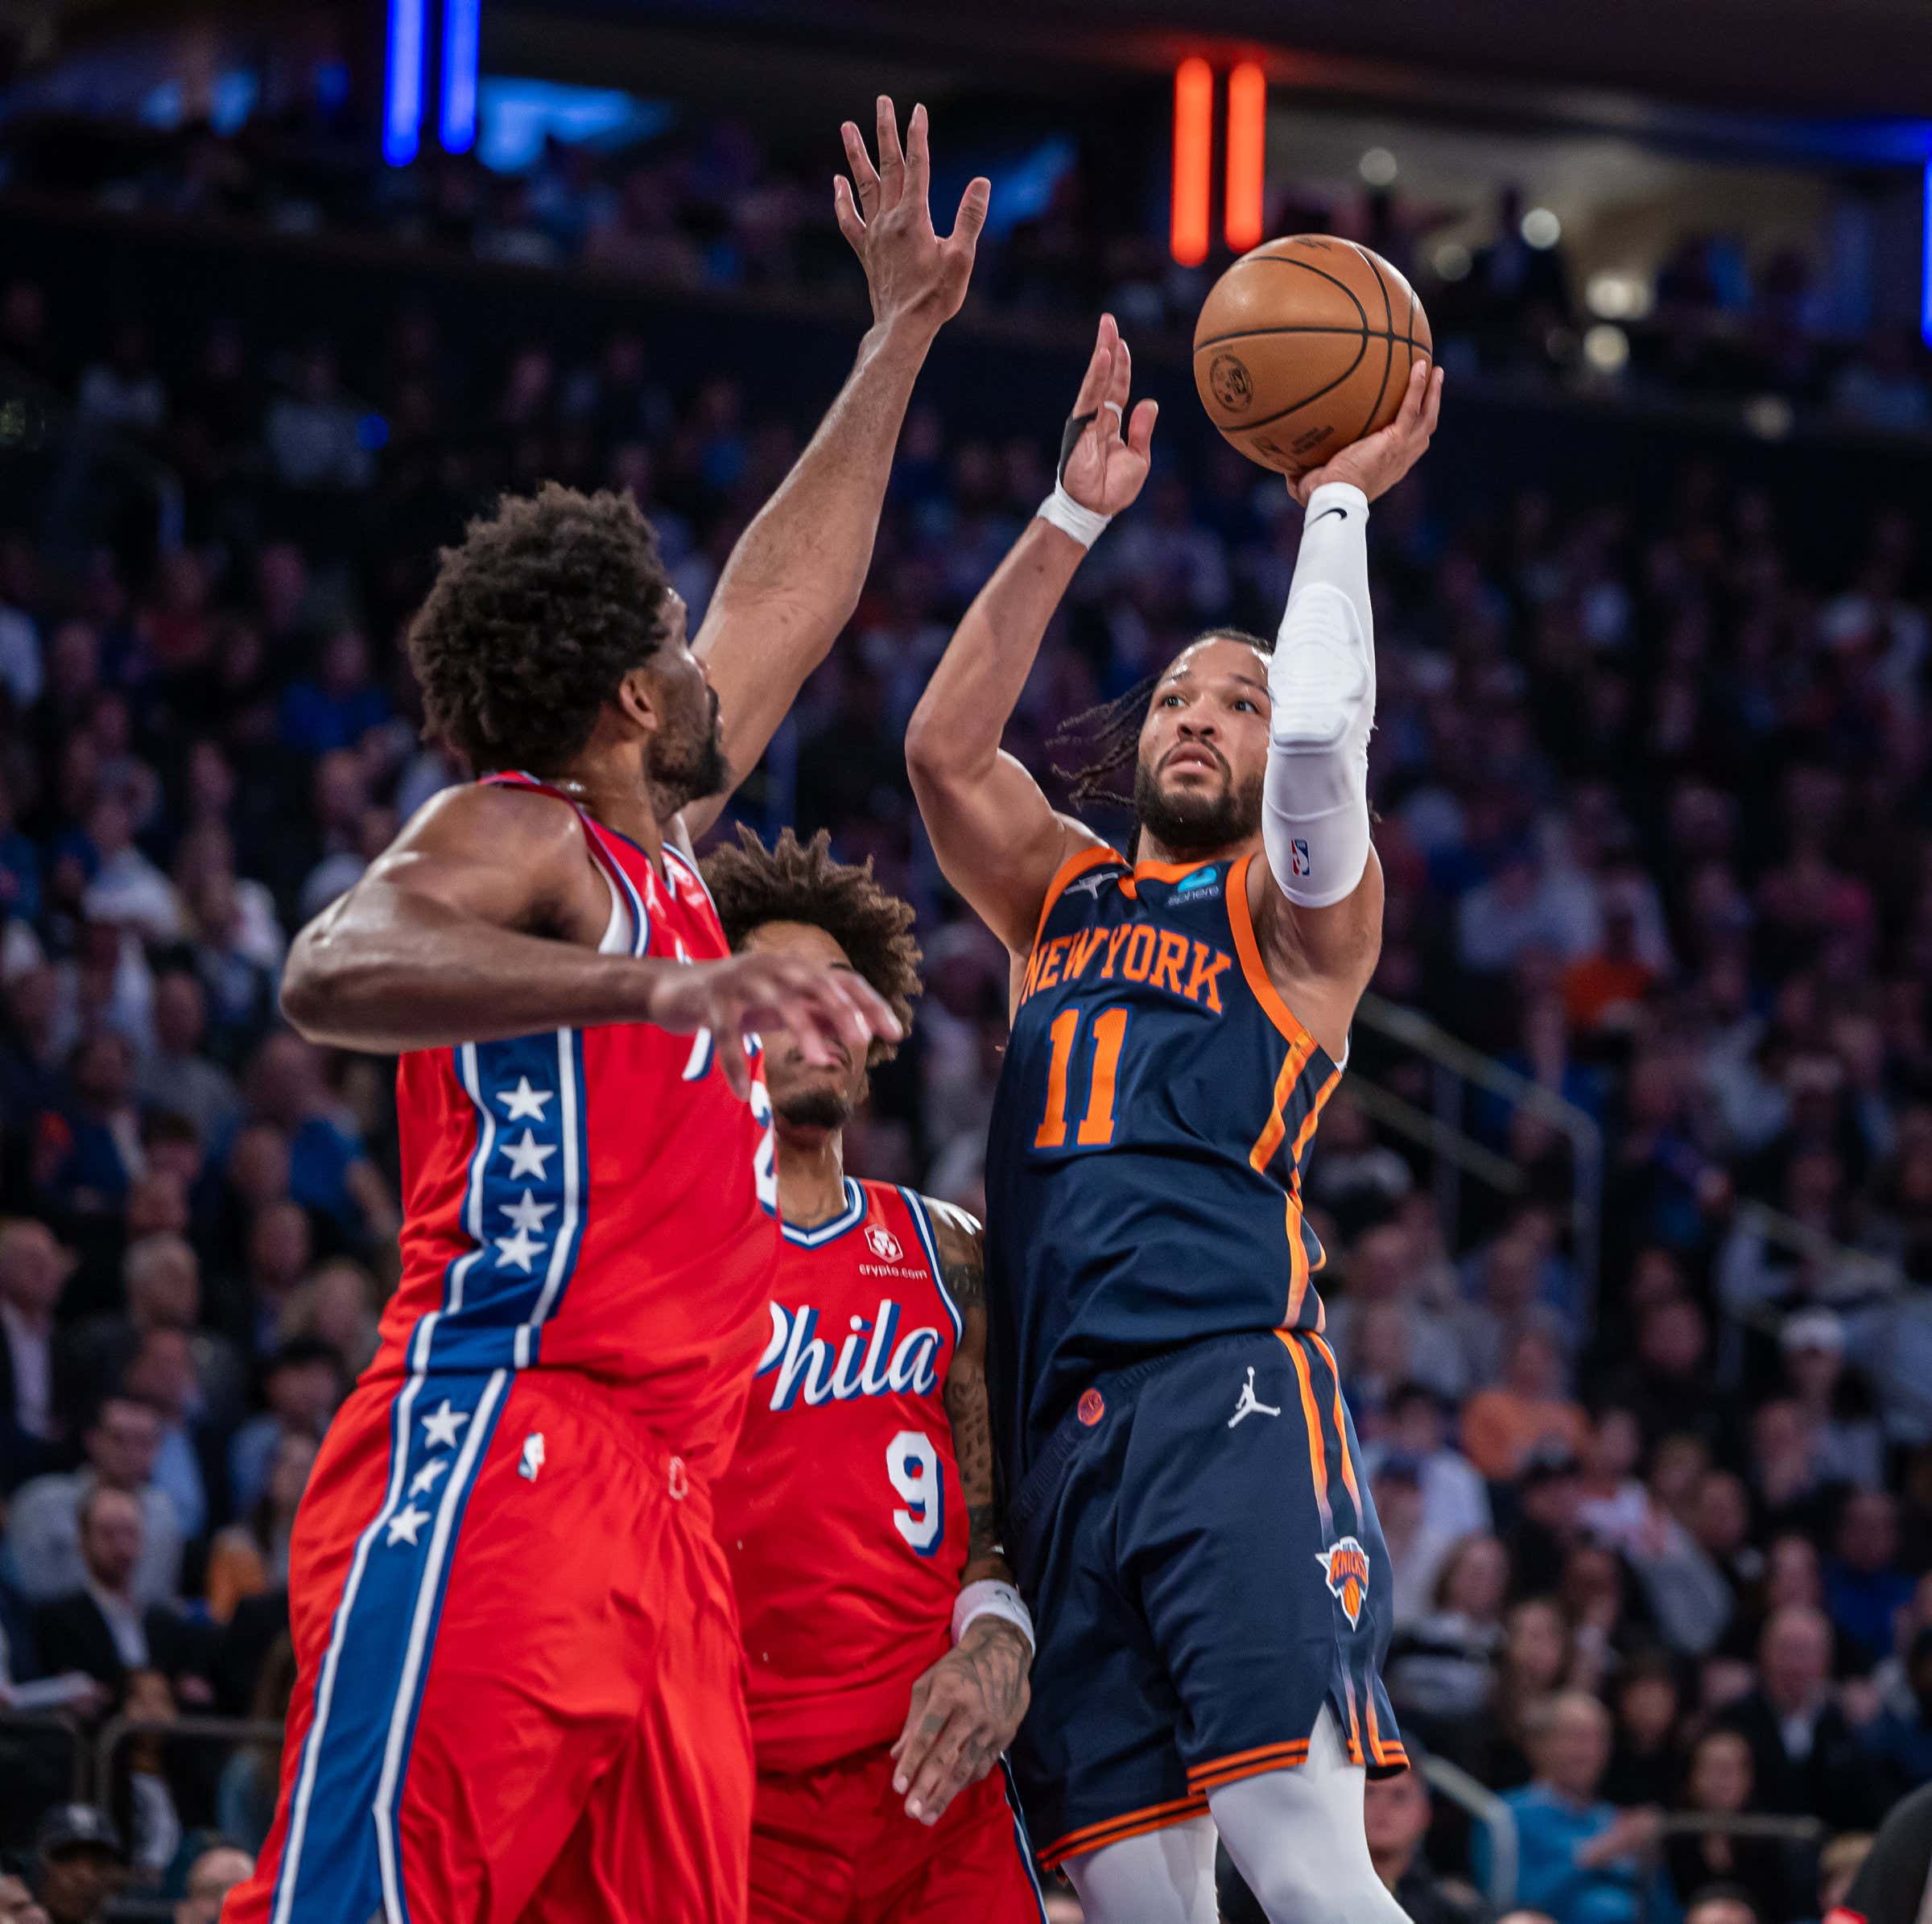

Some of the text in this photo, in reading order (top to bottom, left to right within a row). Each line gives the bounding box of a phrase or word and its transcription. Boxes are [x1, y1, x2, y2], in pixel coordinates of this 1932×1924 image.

[1019, 923, 1232, 1015] NEW YORK
[1032, 1006, 1129, 1149] 11
[858, 1262, 928, 1281] crypto.com
[886, 1430, 943, 1556] 9
[1329, 1549, 1368, 1585] KNICKS
